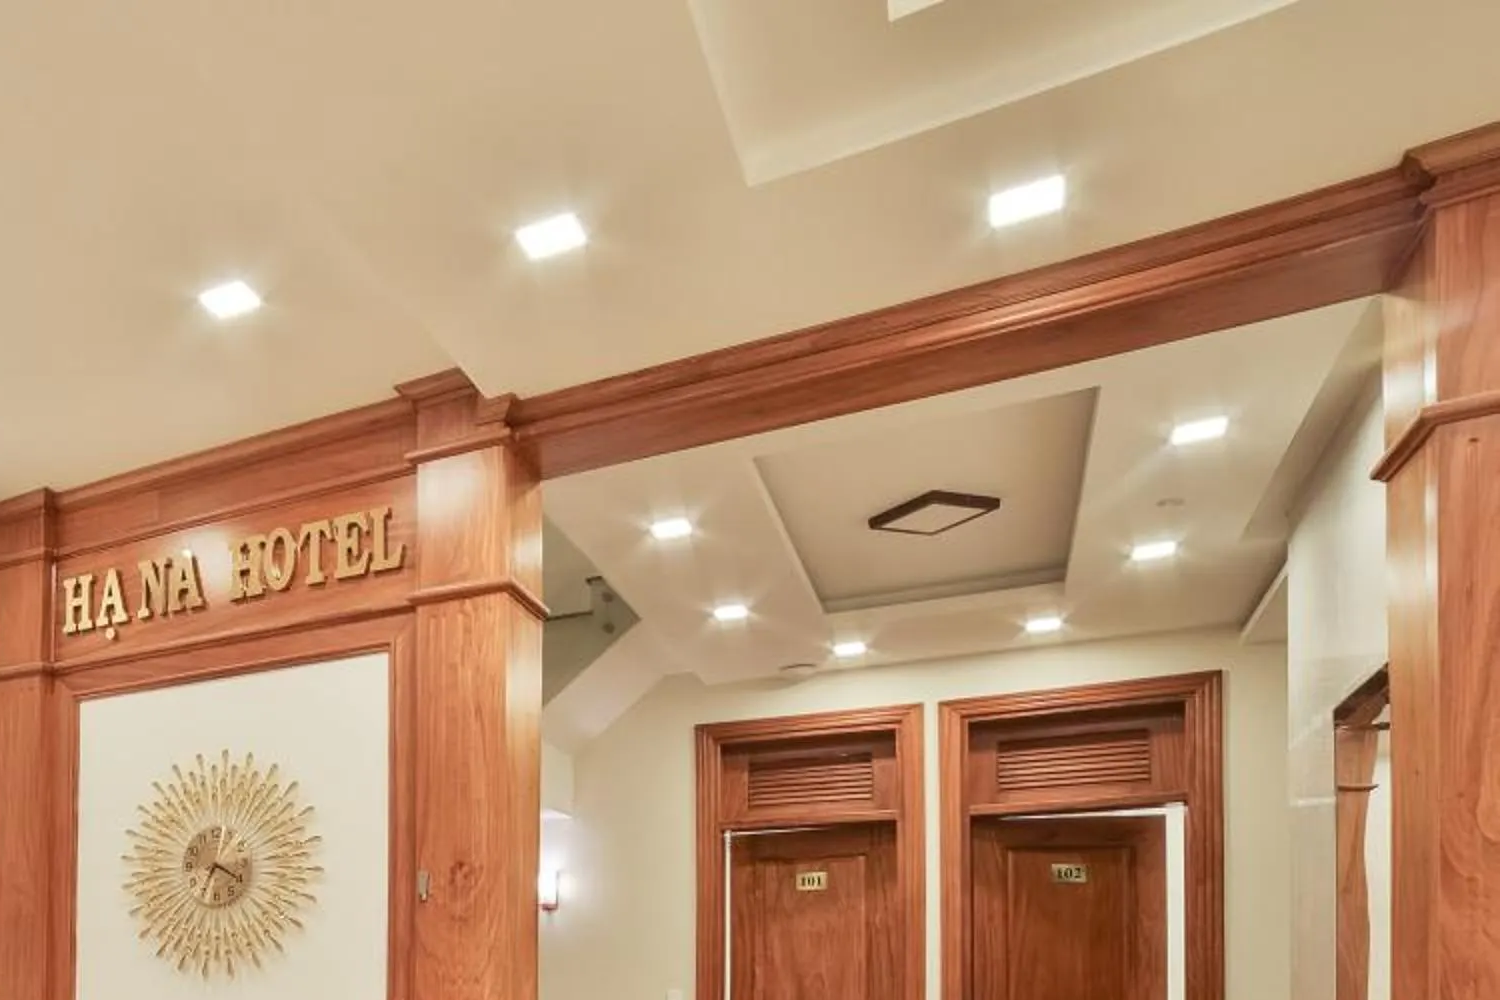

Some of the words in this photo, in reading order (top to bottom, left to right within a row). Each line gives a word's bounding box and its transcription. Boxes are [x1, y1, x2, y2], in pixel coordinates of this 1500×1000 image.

[62, 567, 130, 640] HẠ
[136, 549, 204, 621] NA
[228, 507, 406, 602] HOTEL
[1056, 867, 1083, 880] 102
[800, 875, 822, 887] 101
